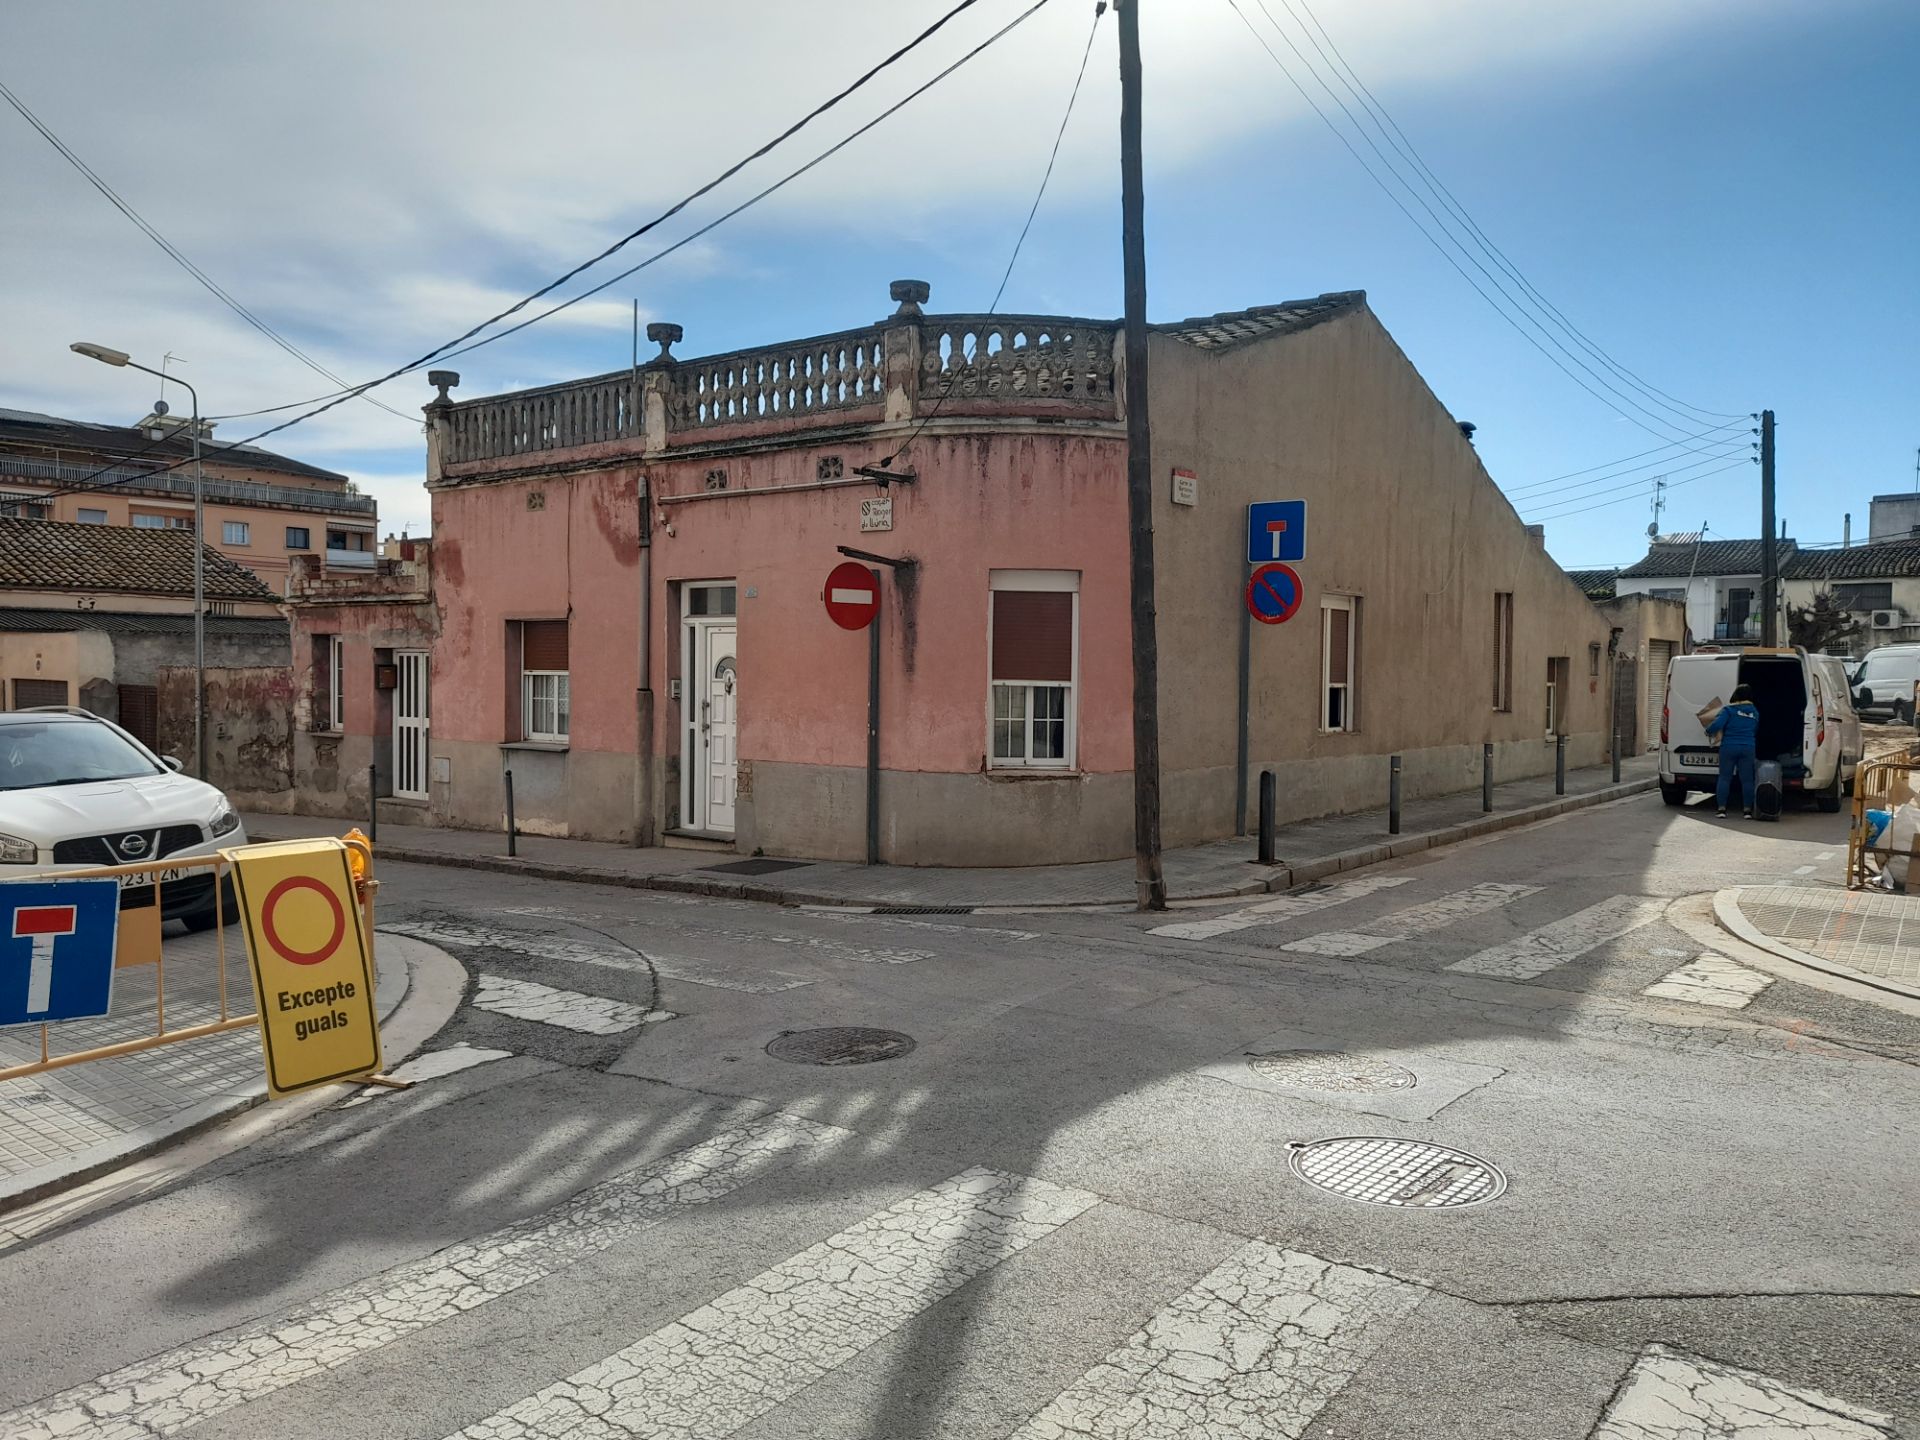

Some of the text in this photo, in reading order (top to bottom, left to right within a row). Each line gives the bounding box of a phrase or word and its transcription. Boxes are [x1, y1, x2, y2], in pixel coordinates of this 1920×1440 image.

[1685, 756, 1706, 764] 4328
[277, 981, 356, 1011] Excepte
[295, 1010, 348, 1041] guals
